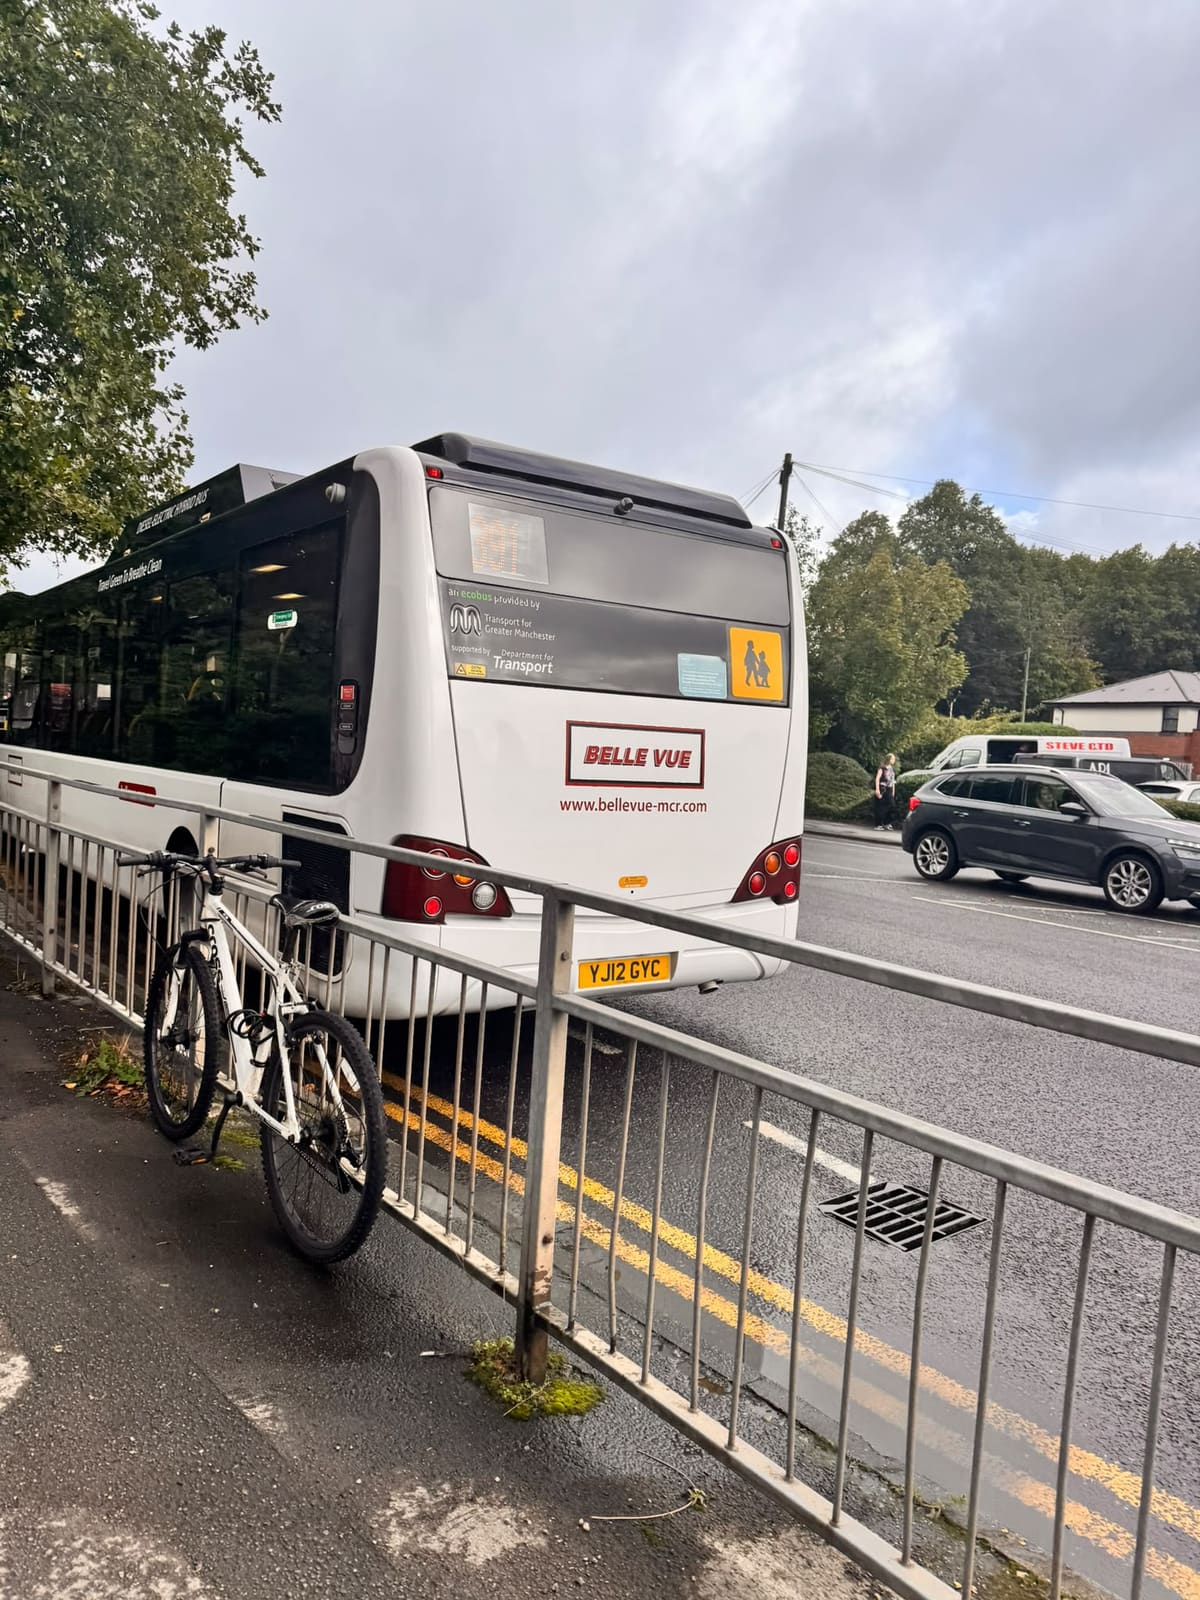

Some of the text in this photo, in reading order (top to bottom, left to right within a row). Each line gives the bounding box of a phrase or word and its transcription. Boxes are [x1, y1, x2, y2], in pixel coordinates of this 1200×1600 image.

[147, 558, 163, 574] Clean
[448, 588, 541, 611] an ecobus provided by
[484, 613, 533, 628] Transport for
[484, 624, 556, 641] Greater Manchester
[501, 648, 555, 662] Department for
[493, 655, 554, 677] Transport
[1045, 741, 1085, 751] STEVE
[584, 745, 693, 769] BELLE VUE
[560, 797, 708, 814] www.bellevue-mcr.com
[589, 959, 661, 983] YJ12 GYC
